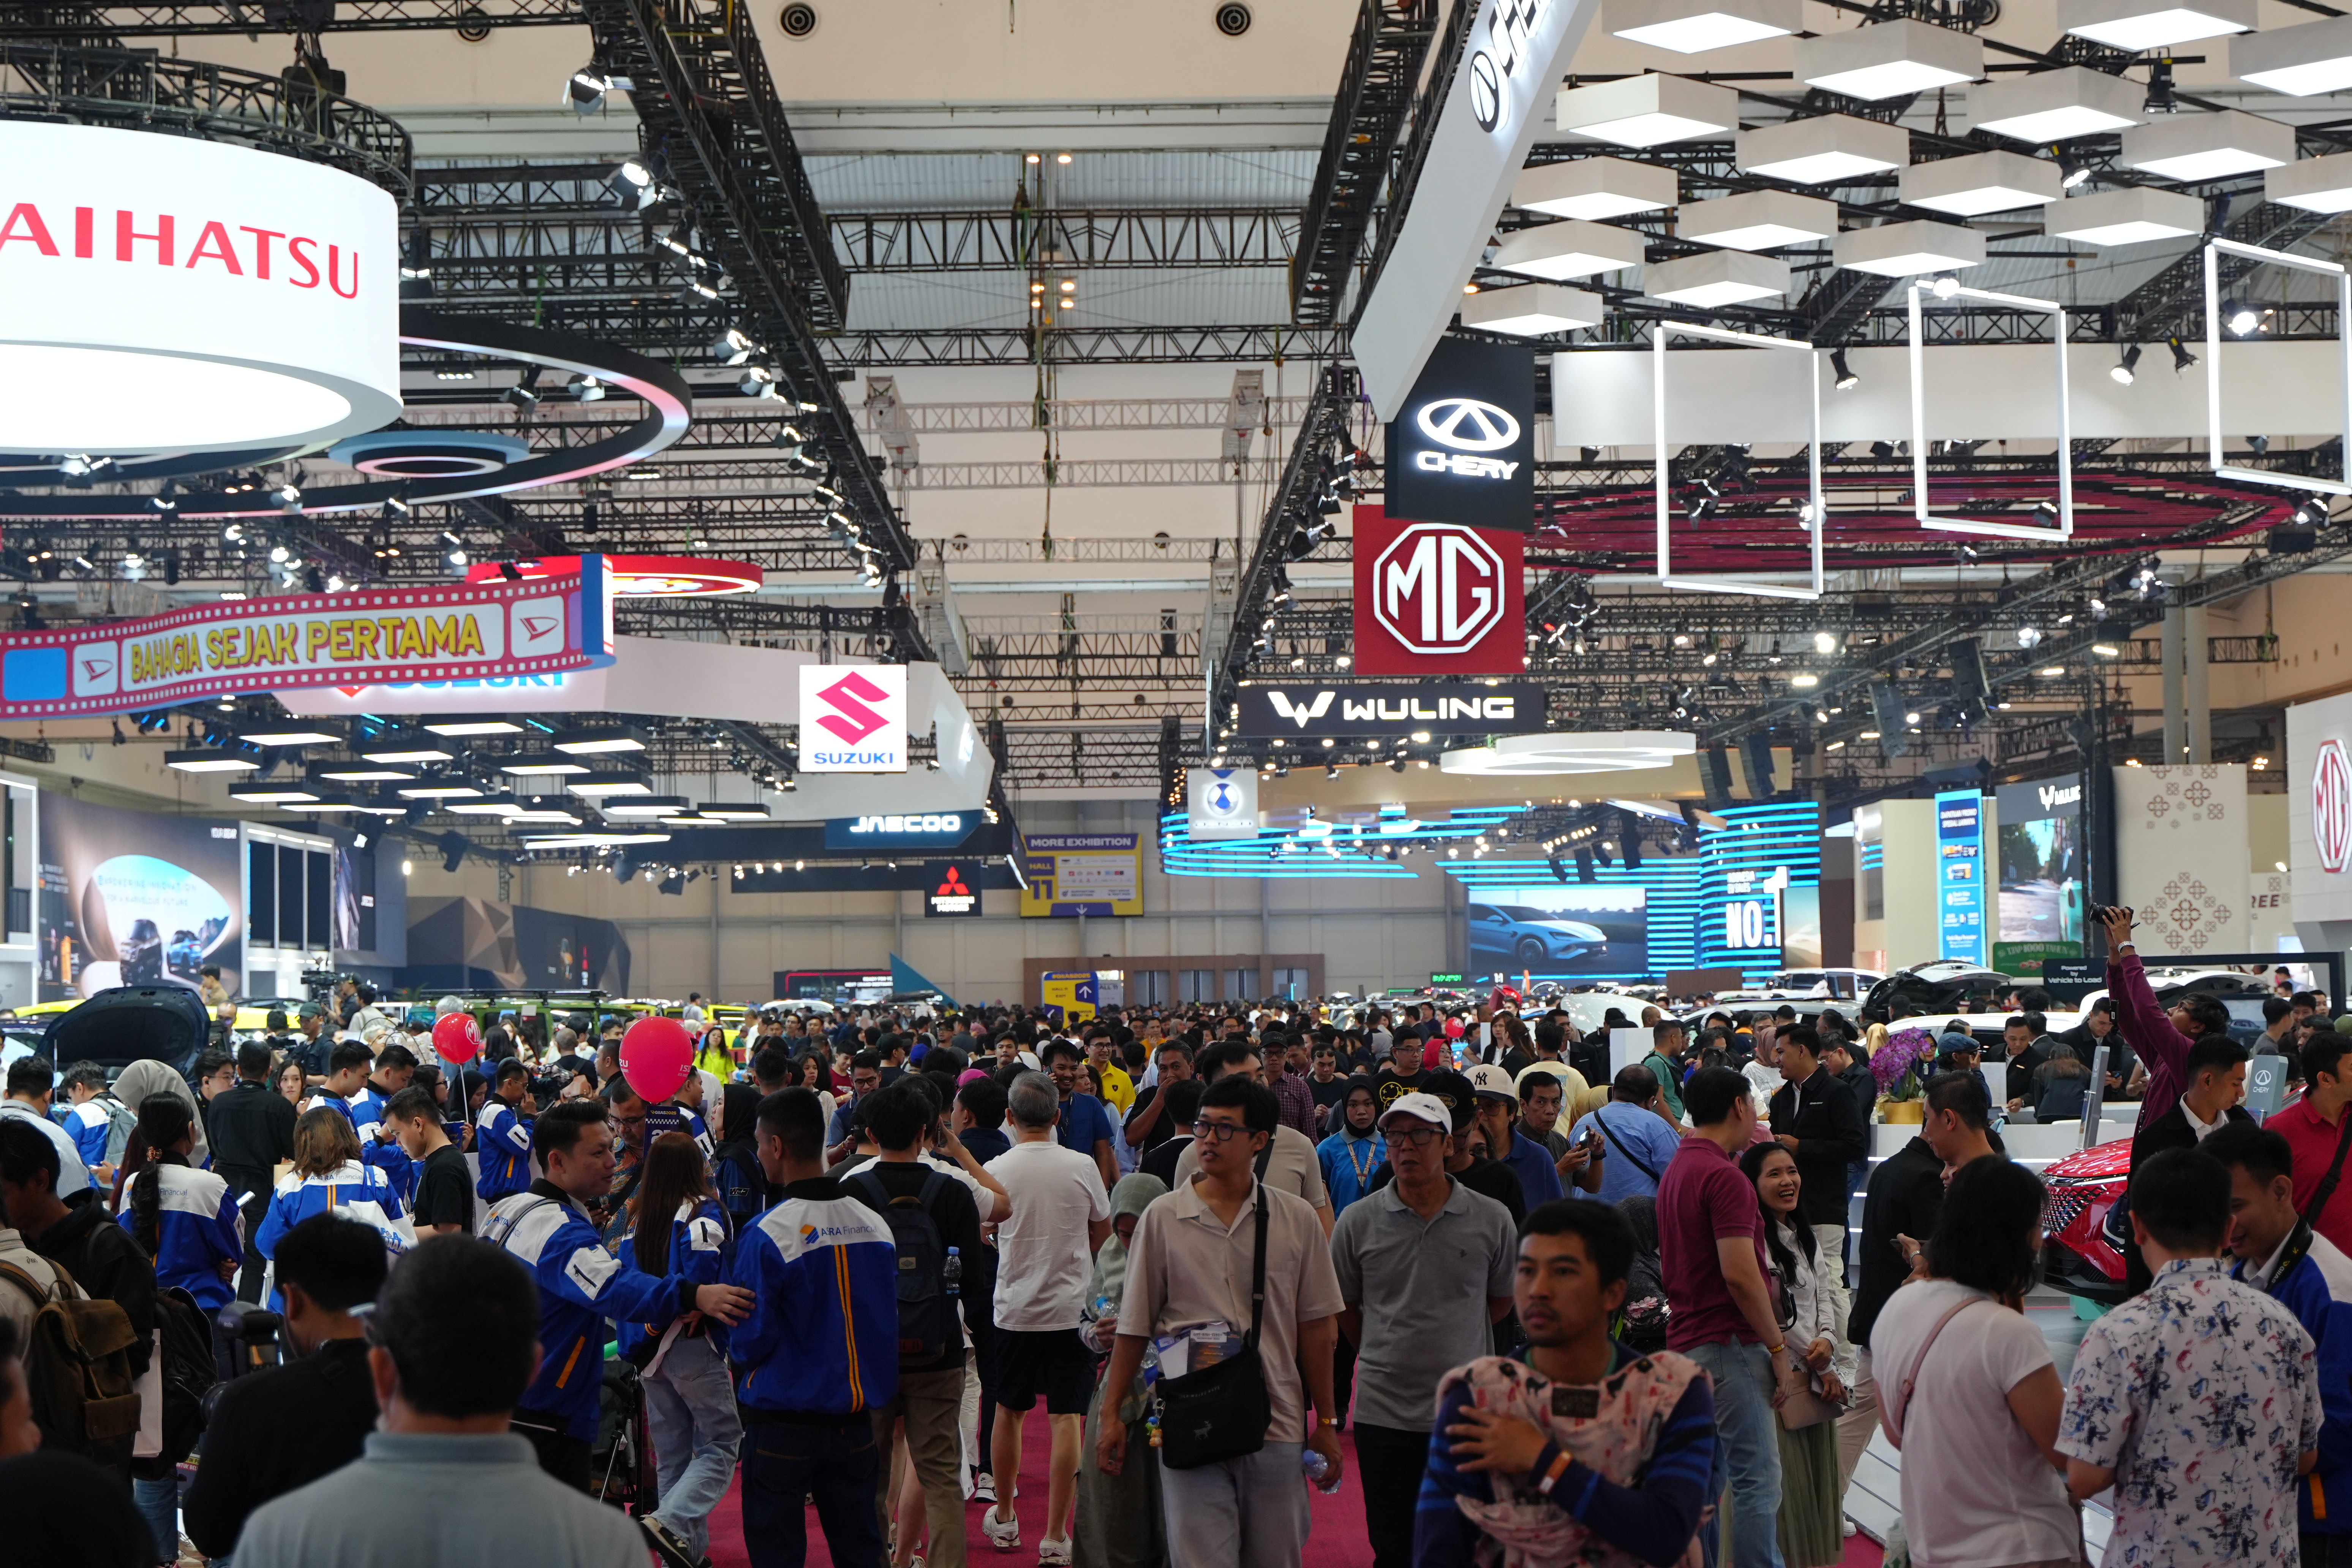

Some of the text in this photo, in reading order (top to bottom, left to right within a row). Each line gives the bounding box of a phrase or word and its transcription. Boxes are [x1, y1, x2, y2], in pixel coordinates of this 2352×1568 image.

[0, 203, 359, 299] AIHATSU
[1416, 450, 1519, 480] CHERY
[1387, 535, 1492, 642] MG
[131, 613, 485, 683] BAHAGIA SEJAK PERTAMA
[1344, 697, 1514, 720] WULING
[814, 752, 893, 764] SUZUKI
[850, 815, 960, 832] JAECOO
[1031, 837, 1131, 847] MORE EXHIBITION
[1475, 1072, 1487, 1085] NY
[159, 1188, 187, 1196] Financial
[843, 1226, 878, 1234] Financial
[2271, 1266, 2284, 1283] GIIAS
